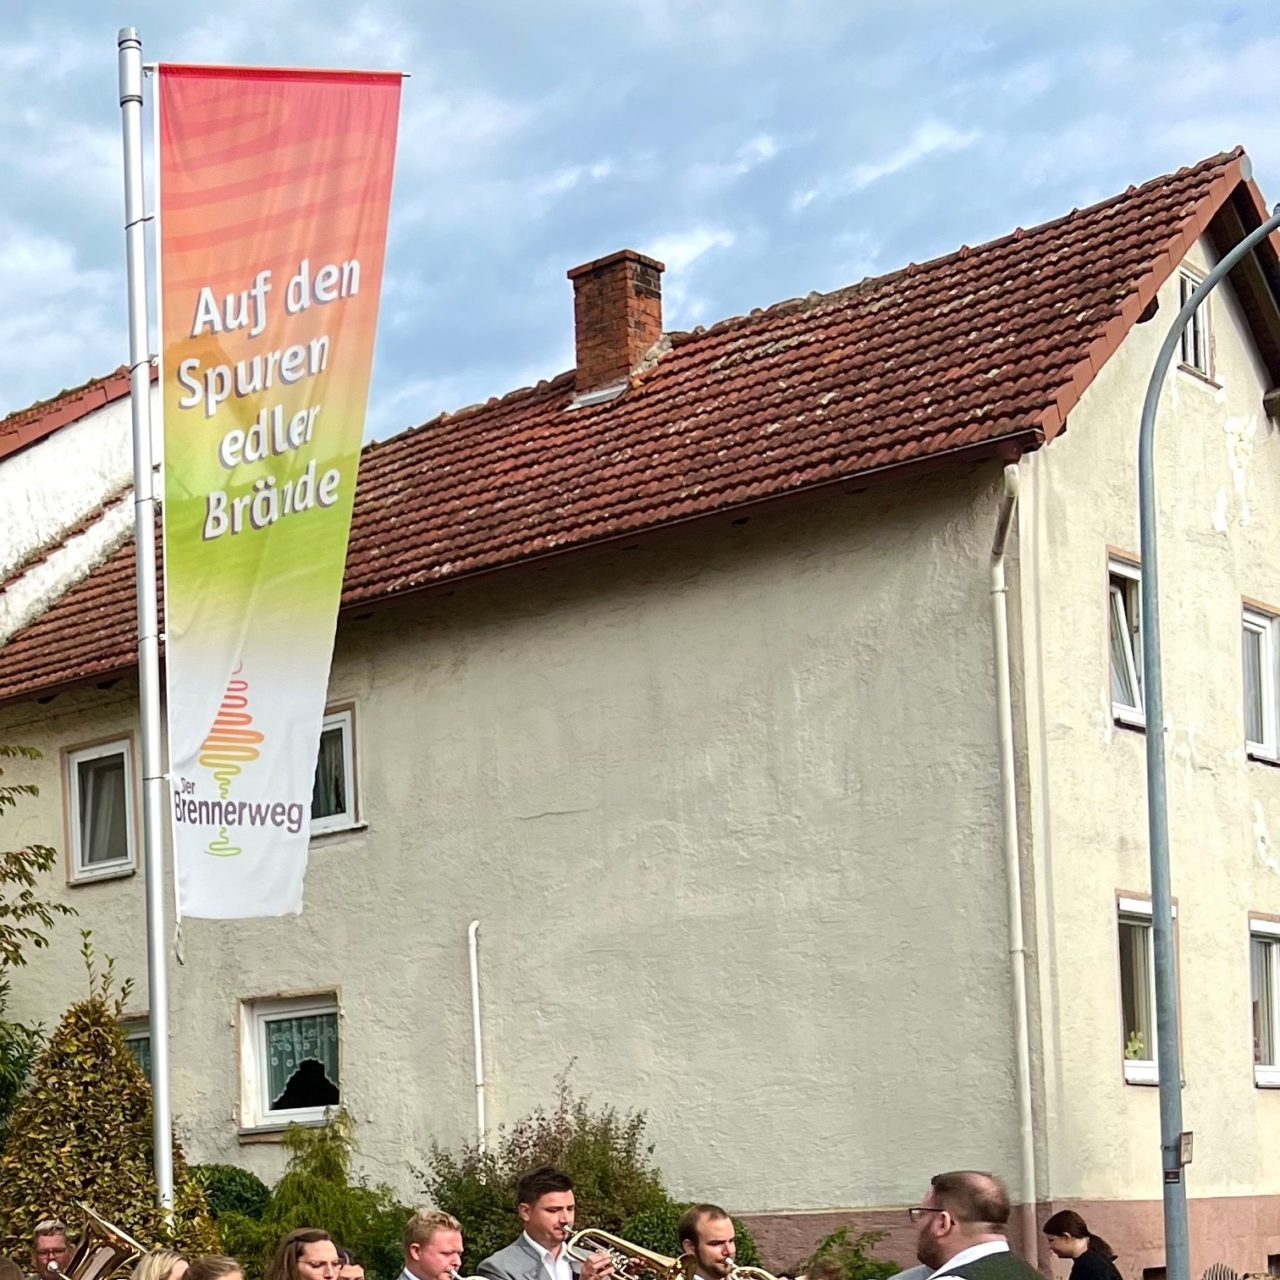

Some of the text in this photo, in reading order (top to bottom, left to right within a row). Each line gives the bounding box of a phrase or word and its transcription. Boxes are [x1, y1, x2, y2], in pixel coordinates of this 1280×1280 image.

[192, 257, 360, 337] Auf den
[178, 333, 330, 416] Spuren
[219, 401, 320, 467] edler
[202, 457, 341, 541] Brände
[174, 790, 303, 834] Brennerweg
